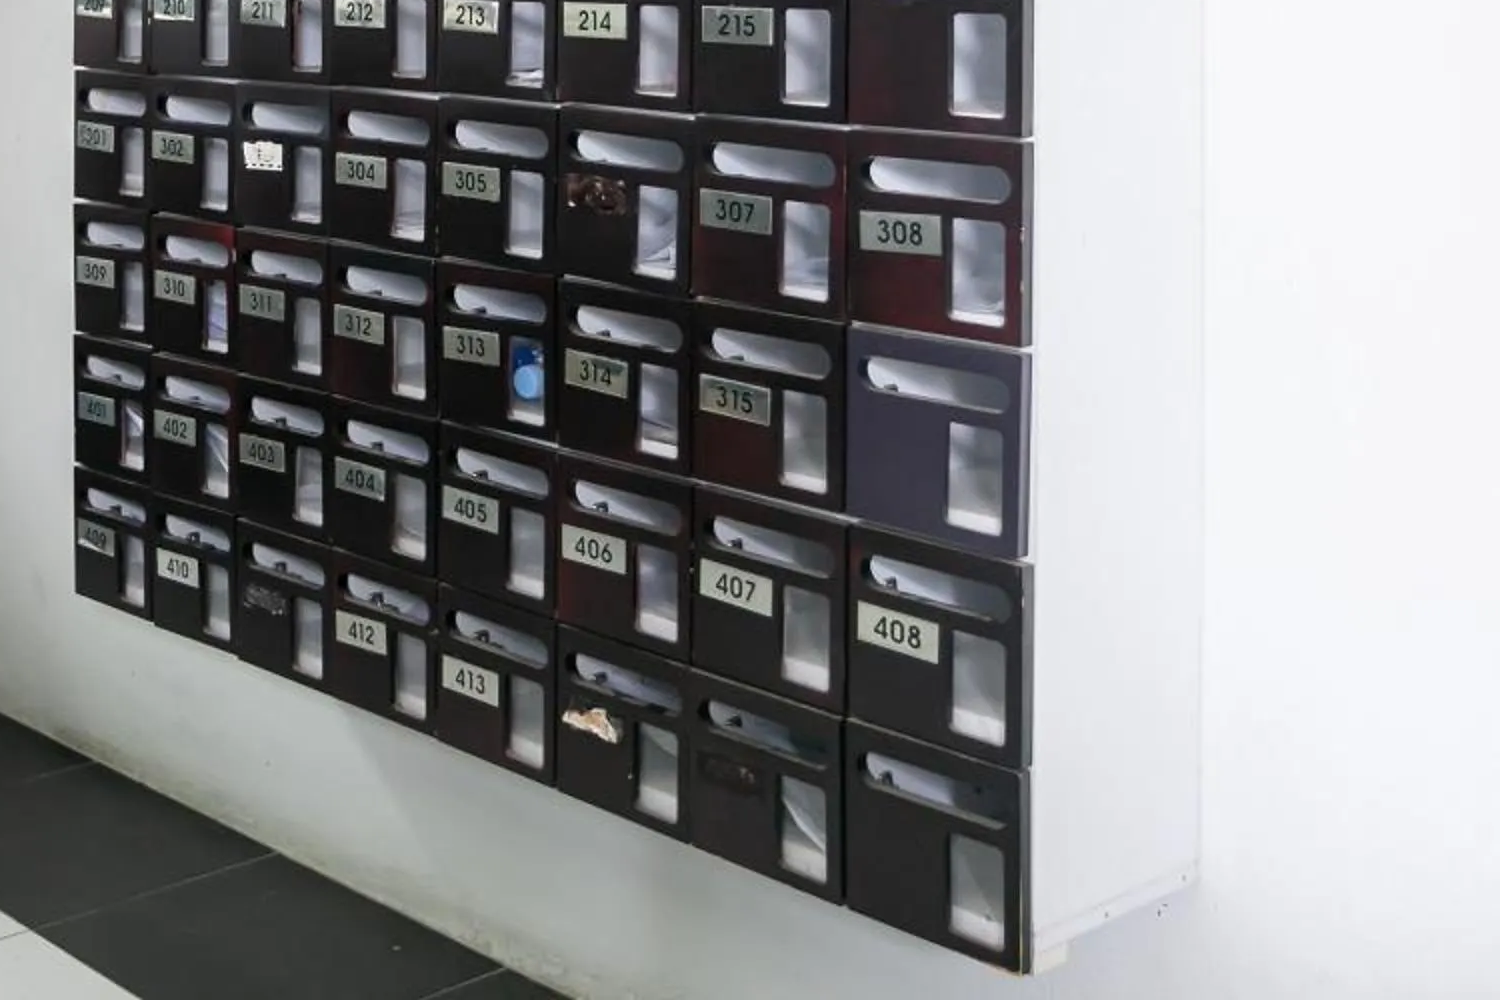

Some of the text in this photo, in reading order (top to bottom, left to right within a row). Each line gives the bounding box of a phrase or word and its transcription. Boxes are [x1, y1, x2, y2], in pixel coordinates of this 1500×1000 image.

[252, 1, 273, 19] 211
[346, 2, 373, 22] 212
[455, 5, 485, 27] 213
[578, 9, 611, 32] 214
[718, 14, 755, 37] 215
[347, 160, 376, 182] 304
[455, 170, 487, 193] 305
[715, 200, 755, 224] 307
[876, 219, 923, 246] 308
[84, 263, 107, 281] 309
[163, 279, 185, 297] 310
[251, 292, 273, 312] 311
[345, 315, 371, 336] 312
[456, 334, 485, 357] 313
[579, 361, 612, 387] 314
[715, 386, 754, 414] 315
[163, 416, 187, 440] 402
[345, 469, 375, 492] 404
[453, 498, 488, 523] 405
[575, 535, 613, 563] 406
[166, 557, 189, 580] 410
[715, 571, 756, 602] 407
[347, 620, 375, 646] 412
[873, 616, 922, 649] 408
[455, 669, 486, 695] 413
